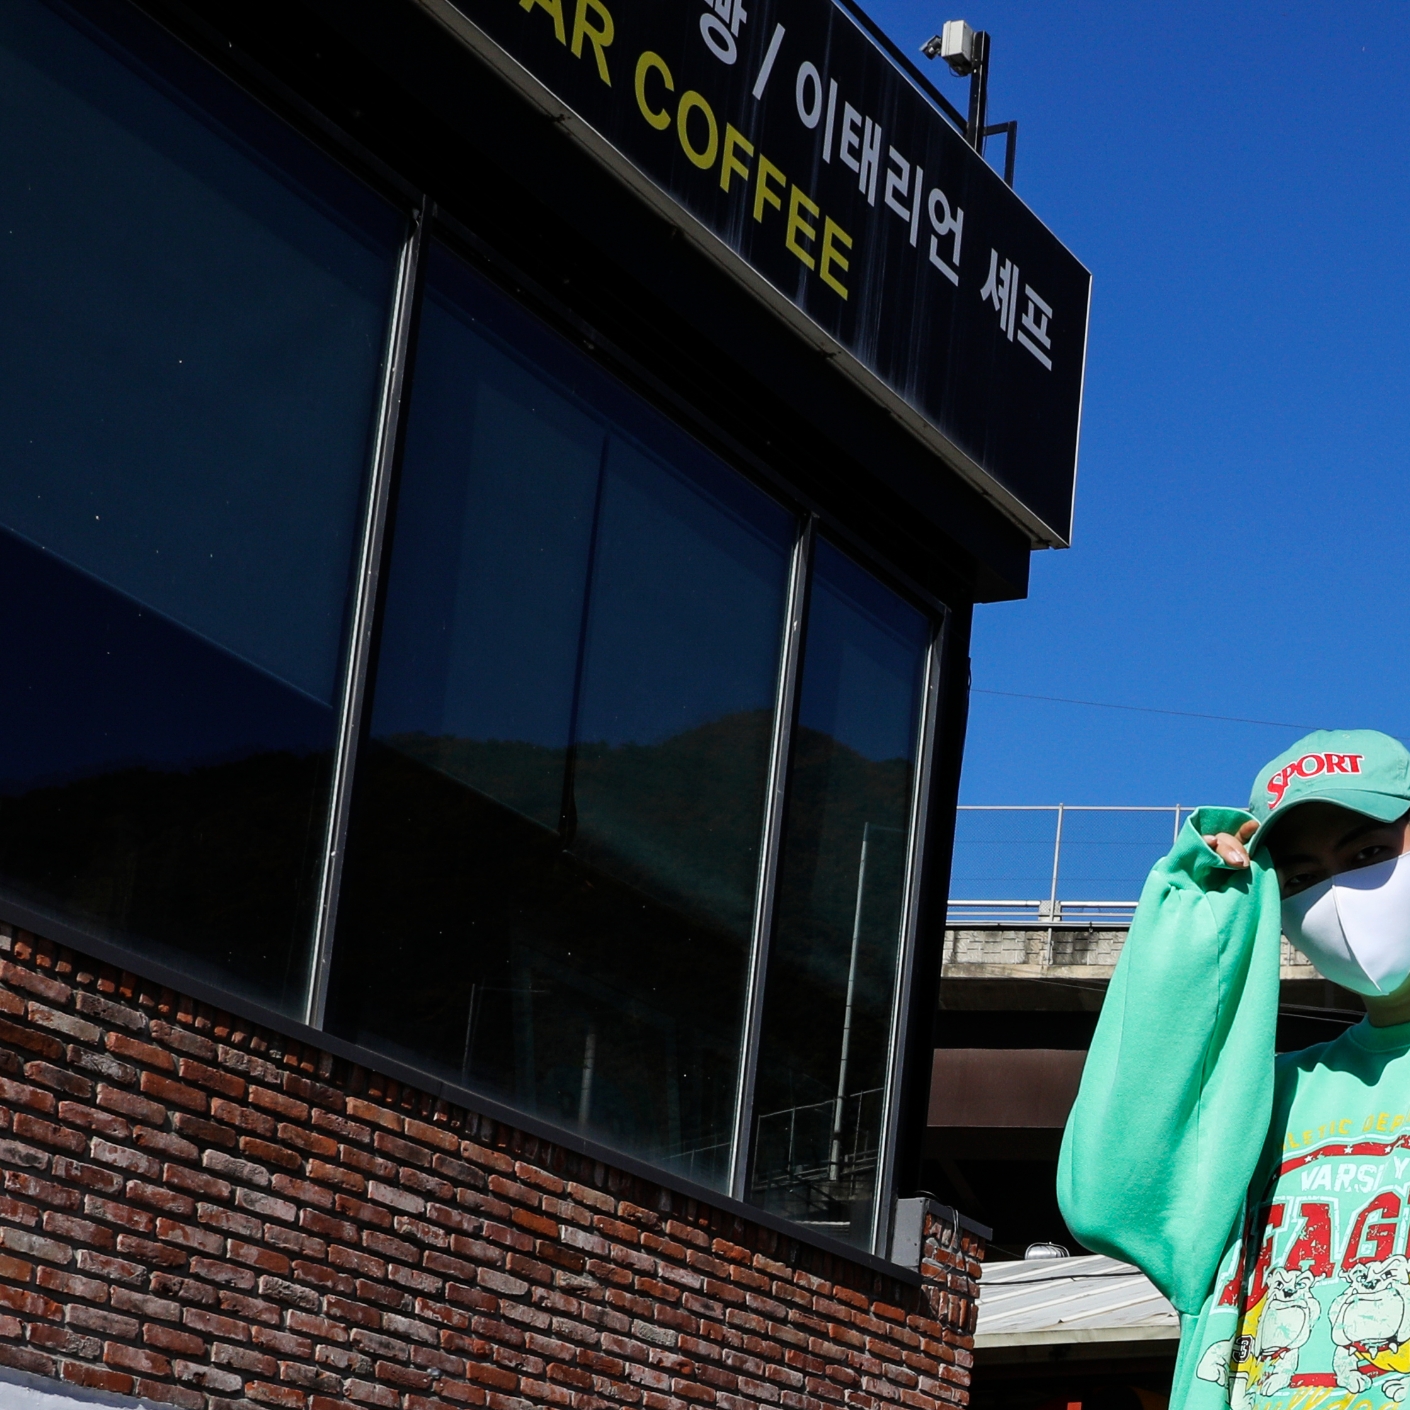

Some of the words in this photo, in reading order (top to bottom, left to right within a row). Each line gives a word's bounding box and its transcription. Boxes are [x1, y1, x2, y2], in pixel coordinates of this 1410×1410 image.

[635, 51, 852, 300] COFFEE
[796, 61, 964, 287] 이태리언
[980, 248, 1052, 371] 셰프
[1267, 753, 1365, 810] SPORT
[1281, 1119, 1353, 1151] LETIC
[1301, 1156, 1410, 1193] VARSIY
